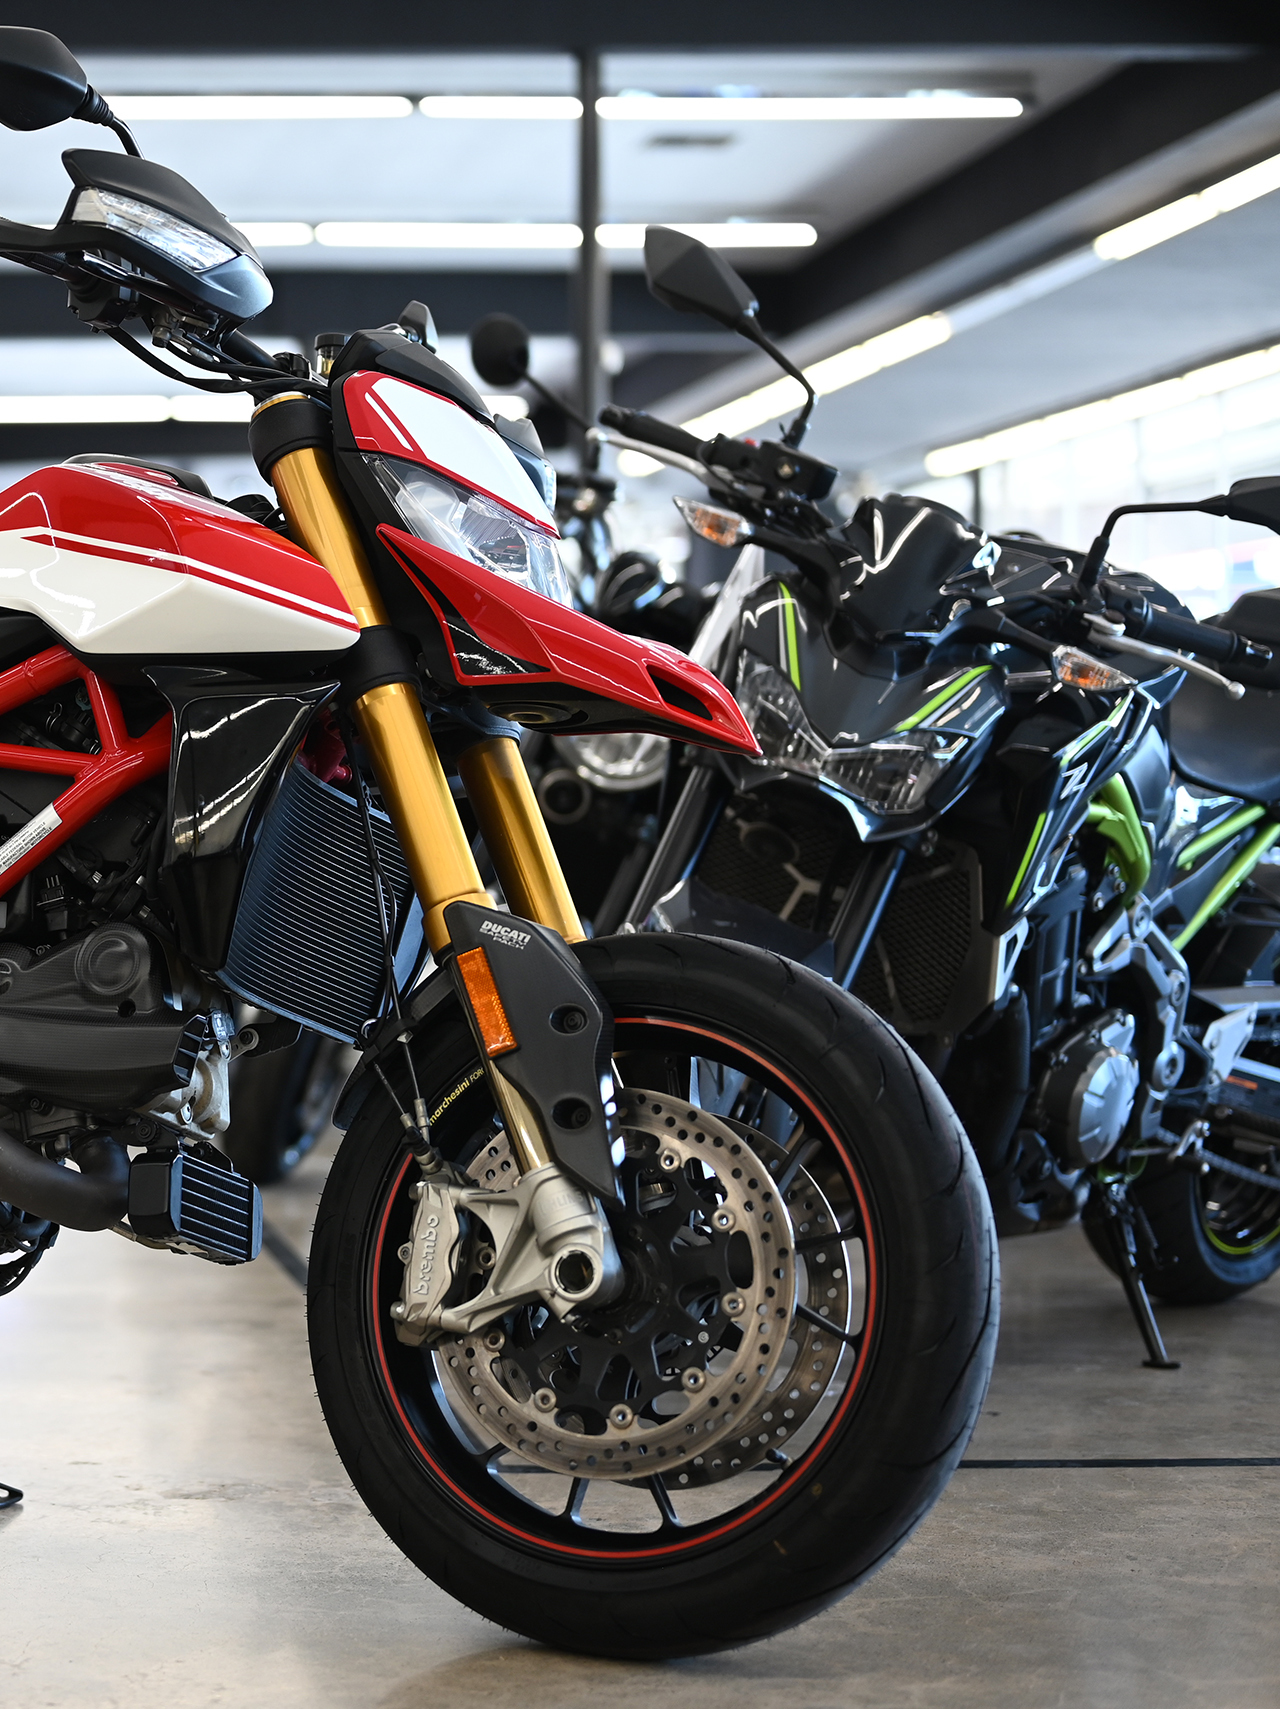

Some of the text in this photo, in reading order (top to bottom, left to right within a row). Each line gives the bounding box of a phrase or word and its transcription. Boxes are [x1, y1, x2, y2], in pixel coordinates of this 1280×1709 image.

[481, 920, 531, 943] DUCATI
[429, 1078, 470, 1126] marchesini
[412, 1214, 440, 1296] brembo
